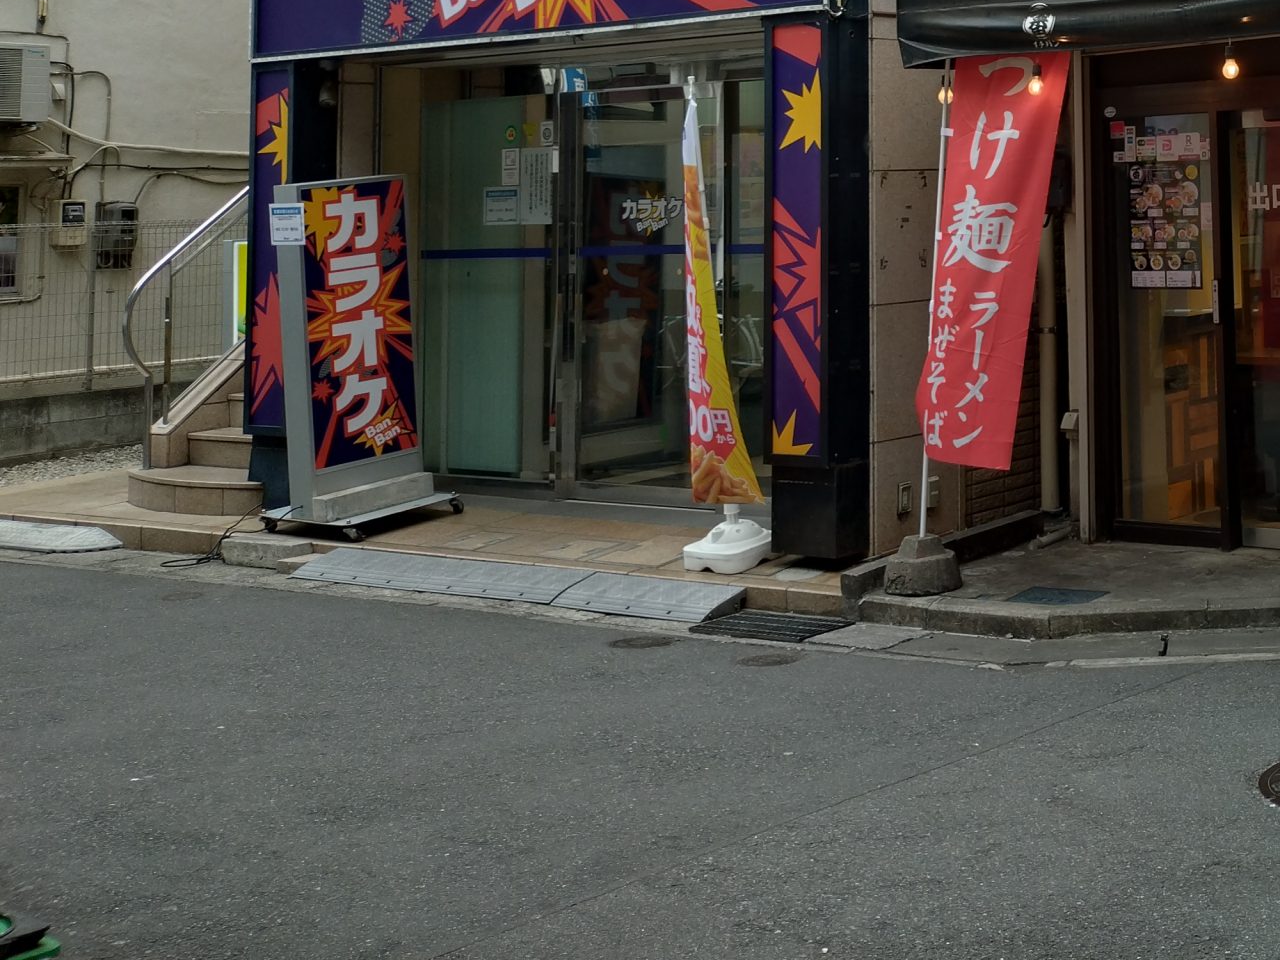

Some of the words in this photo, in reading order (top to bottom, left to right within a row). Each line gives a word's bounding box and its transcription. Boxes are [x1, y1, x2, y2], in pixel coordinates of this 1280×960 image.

[942, 57, 1036, 273] つけ麺
[621, 197, 683, 220] カラオケ
[636, 219, 652, 232] Ban
[651, 218, 669, 231] Ban
[325, 192, 387, 433] カラオケ
[924, 278, 960, 449] まぜそば
[953, 291, 999, 449] ラーメン
[365, 417, 393, 439] Ban
[374, 425, 401, 446] Ban
[716, 432, 736, 444] から
